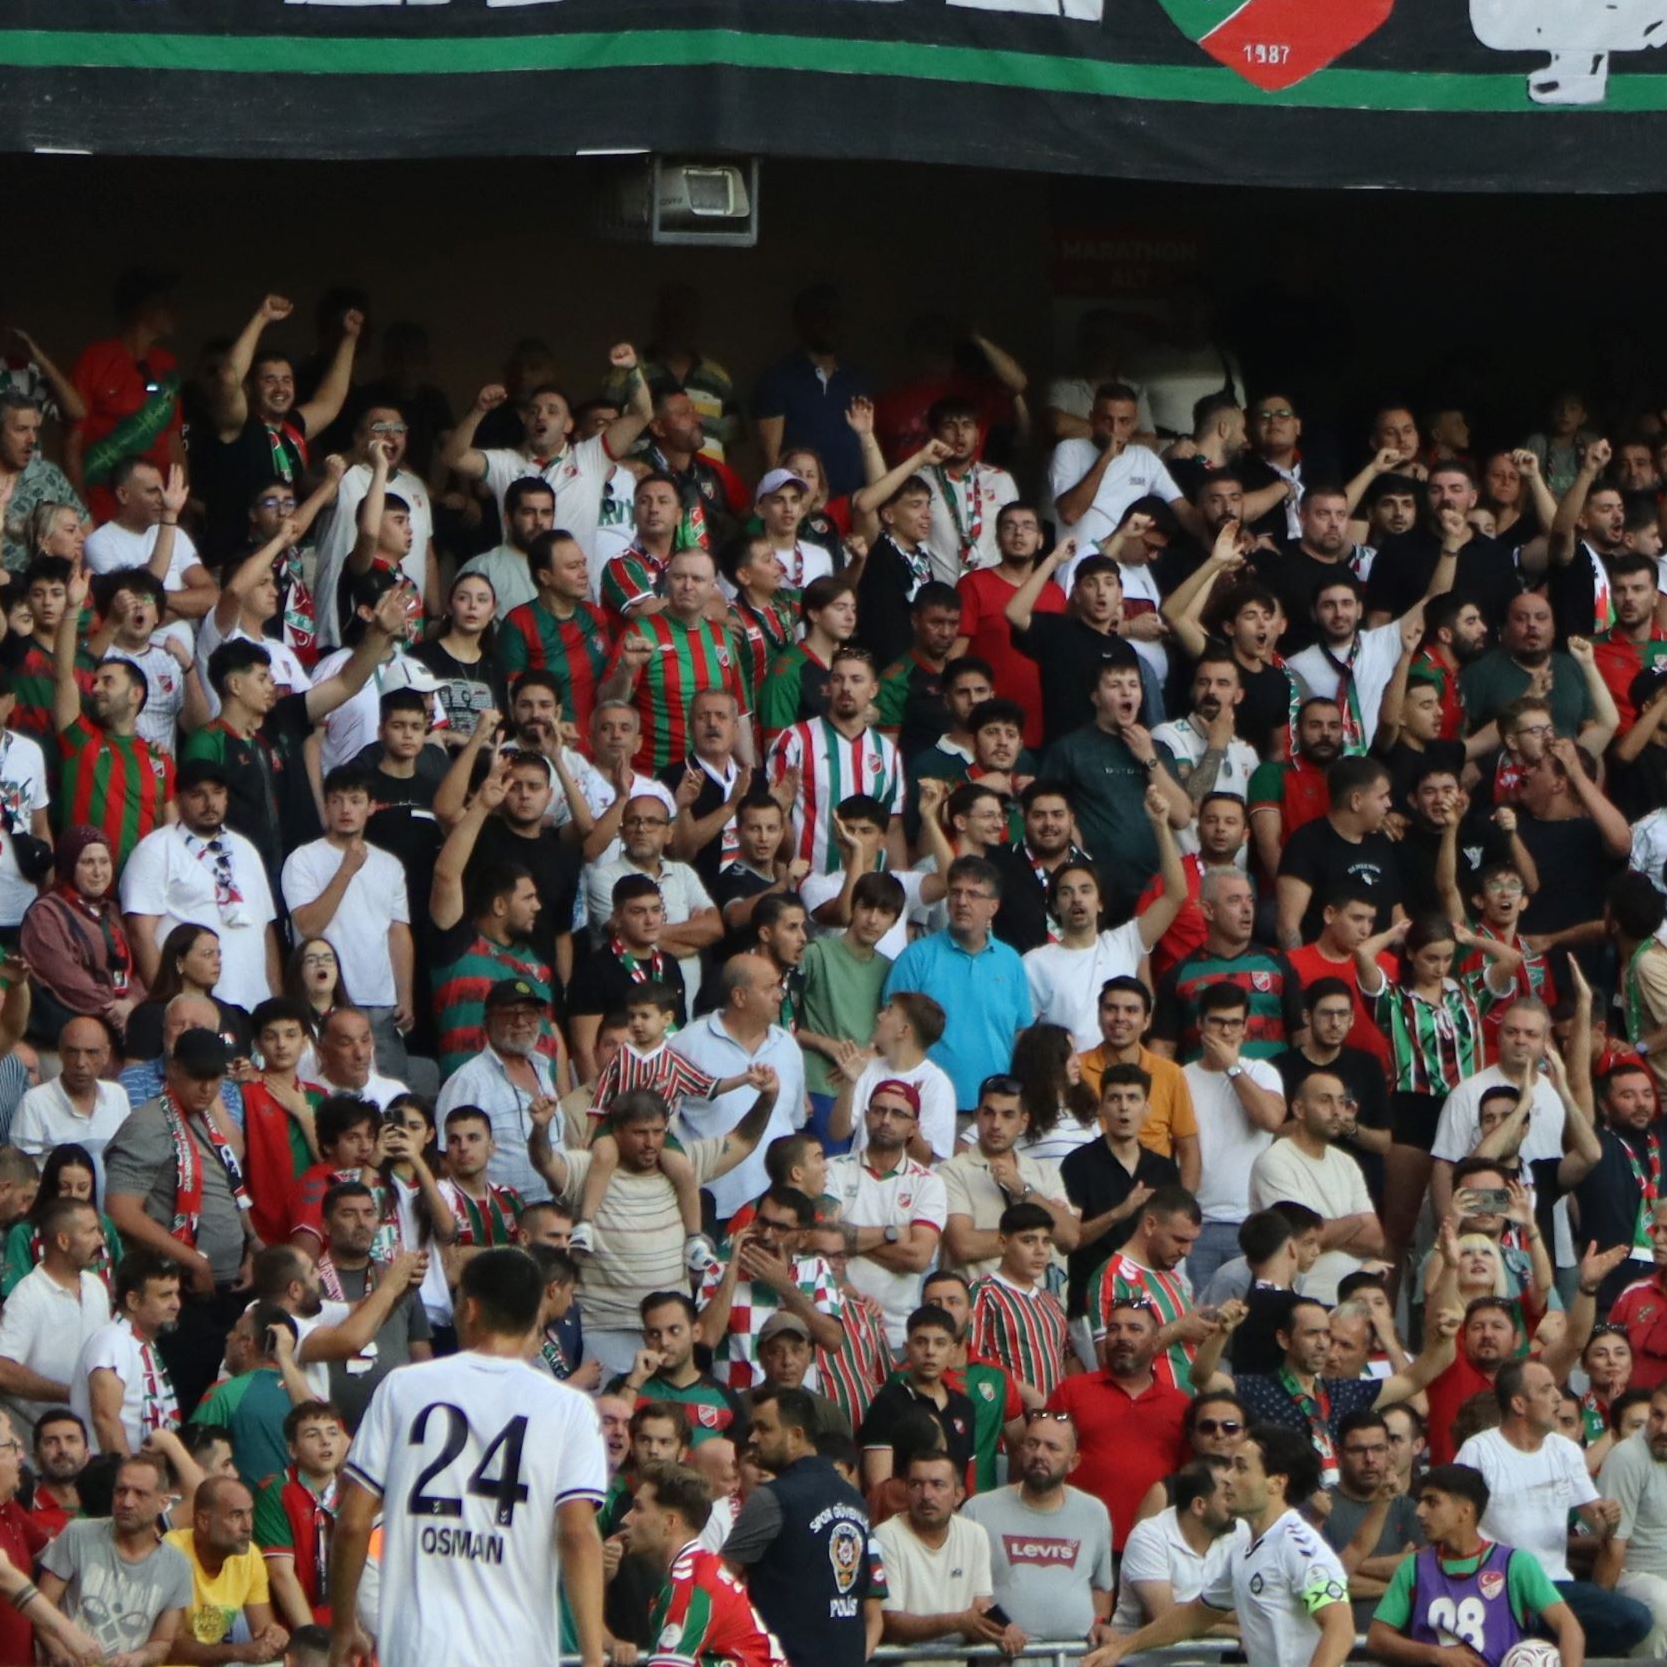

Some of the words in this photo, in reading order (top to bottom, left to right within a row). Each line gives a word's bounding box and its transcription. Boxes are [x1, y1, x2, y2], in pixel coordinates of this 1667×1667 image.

[1242, 44, 1291, 65] 1987
[1061, 239, 1199, 263] MARATHON
[407, 1401, 529, 1528] 24
[809, 1508, 833, 1534] SPOR
[421, 1526, 503, 1565] OSMAN
[829, 1594, 859, 1619] POLİS
